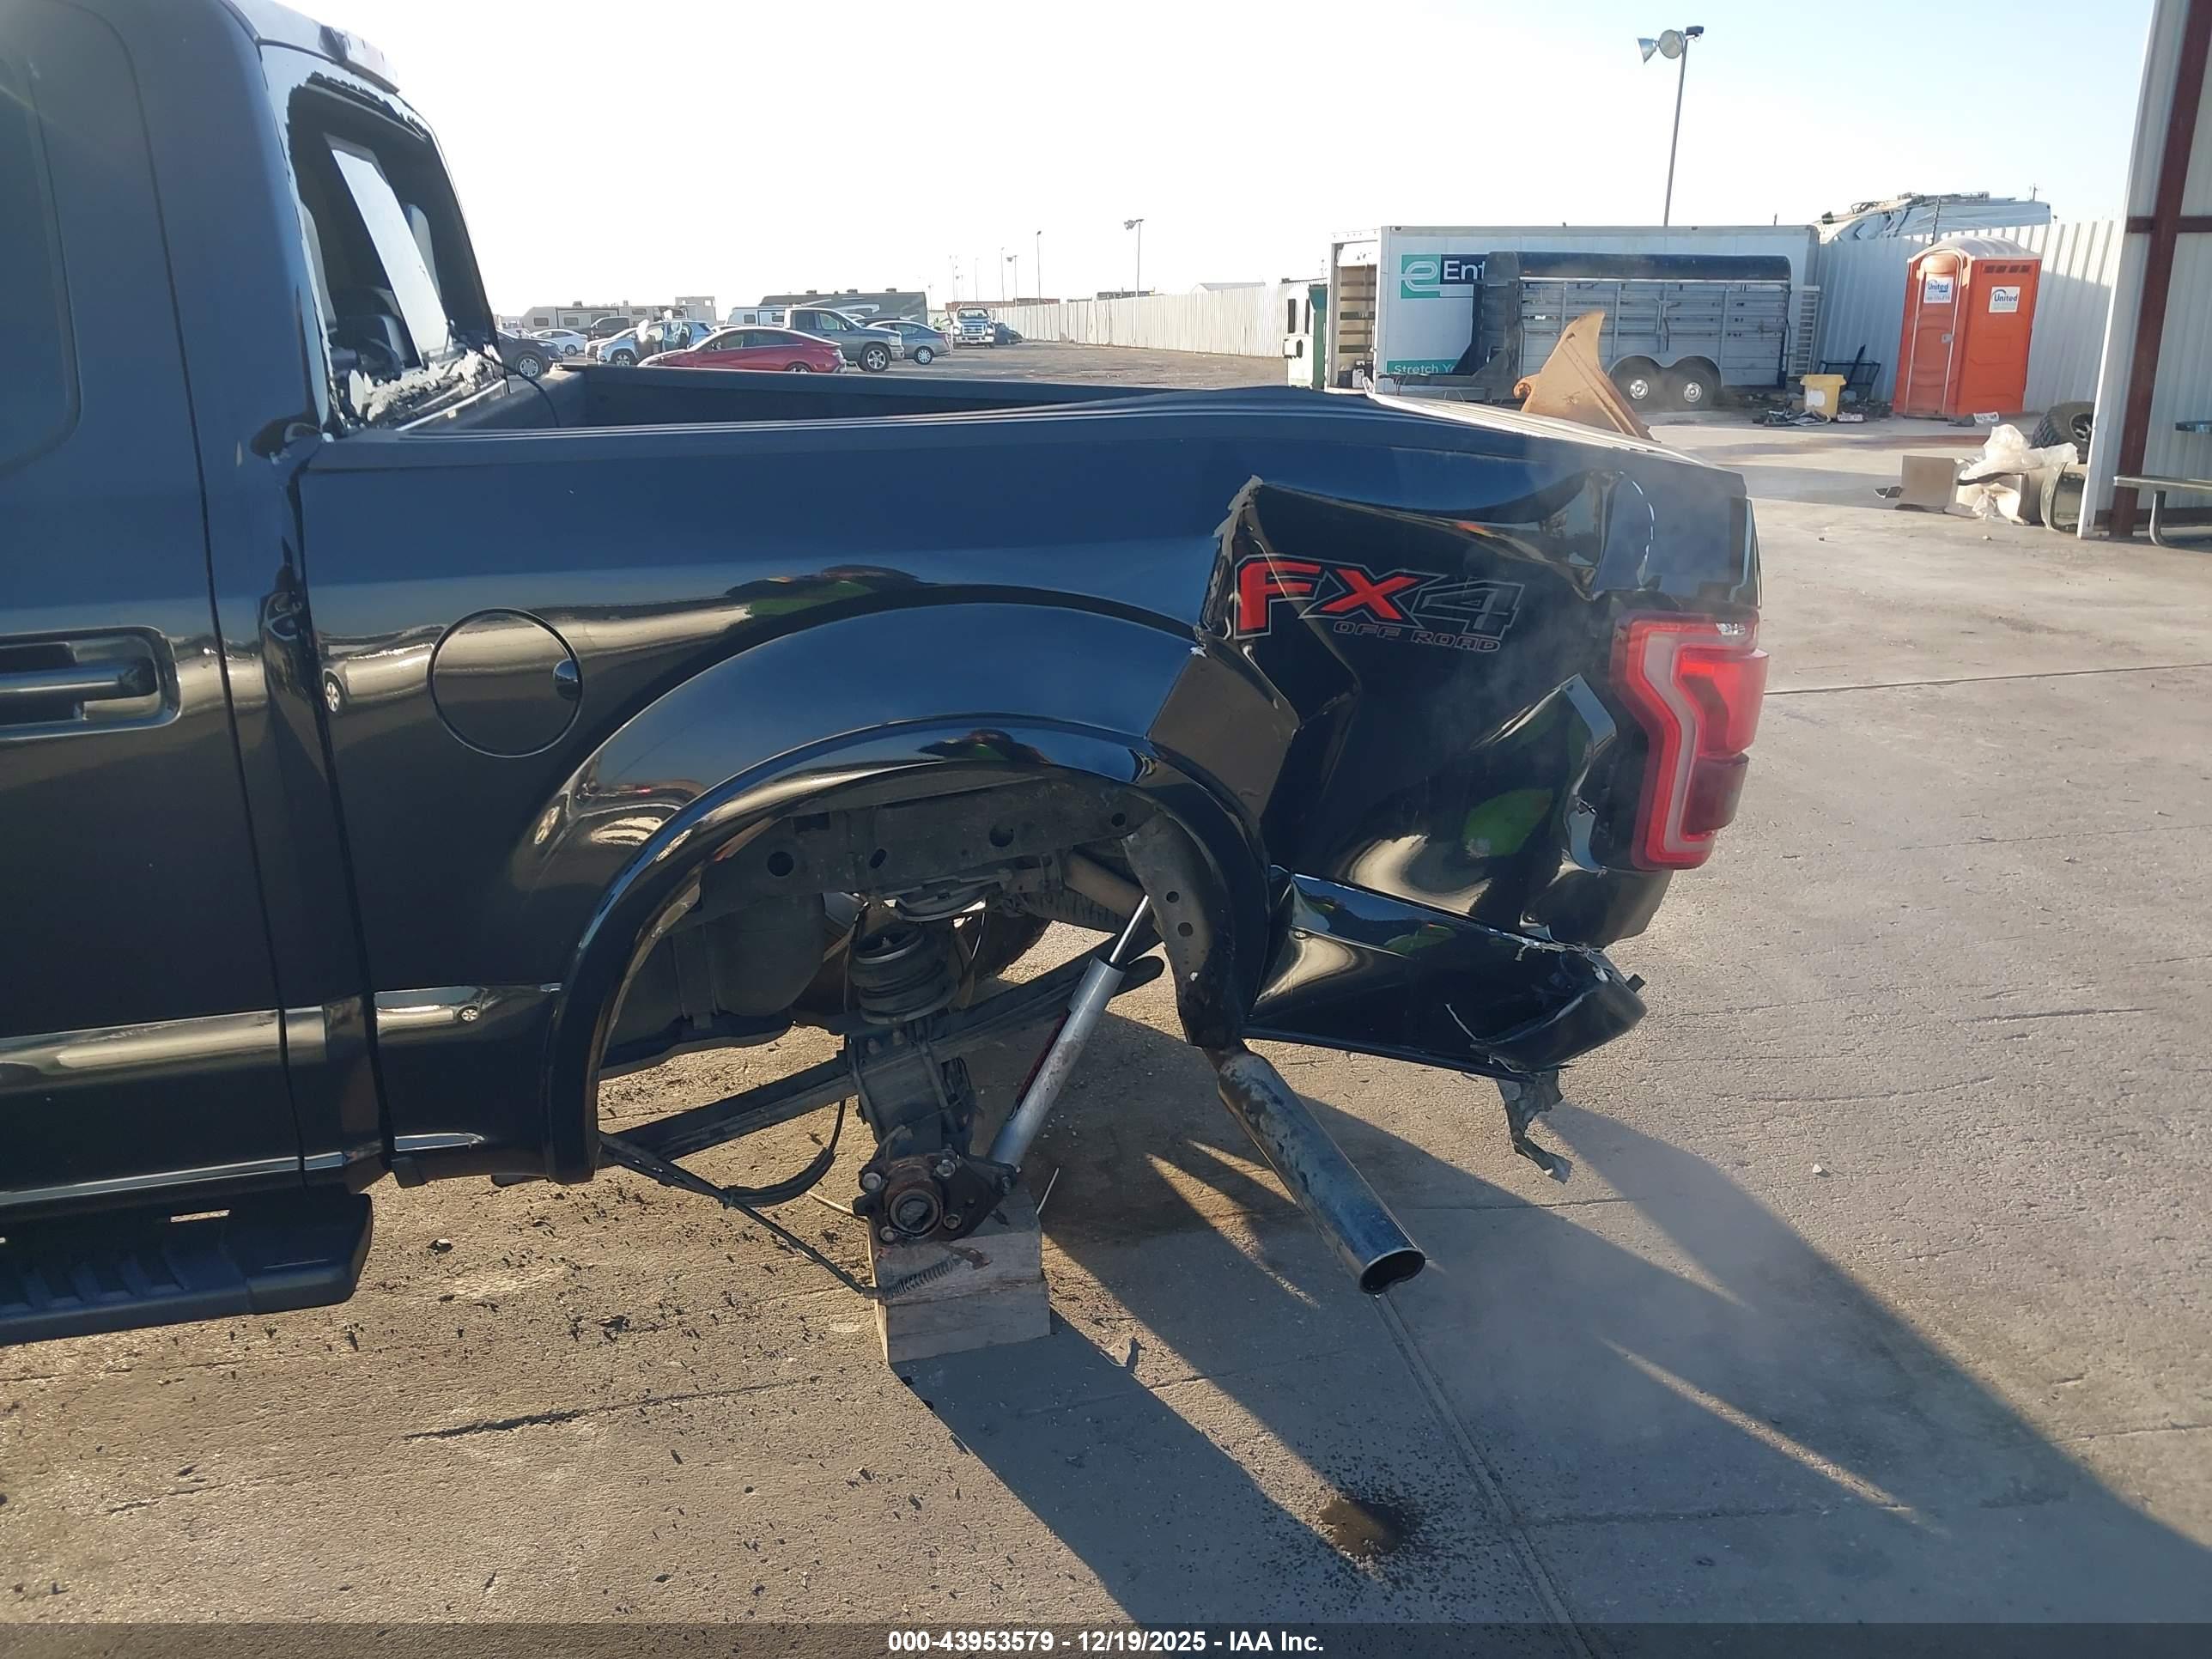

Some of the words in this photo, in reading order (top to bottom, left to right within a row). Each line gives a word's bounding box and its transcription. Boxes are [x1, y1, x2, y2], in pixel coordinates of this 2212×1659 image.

[1928, 283, 1949, 291] United
[1994, 292, 2018, 302] United
[1395, 364, 1439, 374] Stretch
[1234, 553, 1525, 640] FX4
[1333, 620, 1401, 641] OFF
[1412, 630, 1502, 653] ROAD
